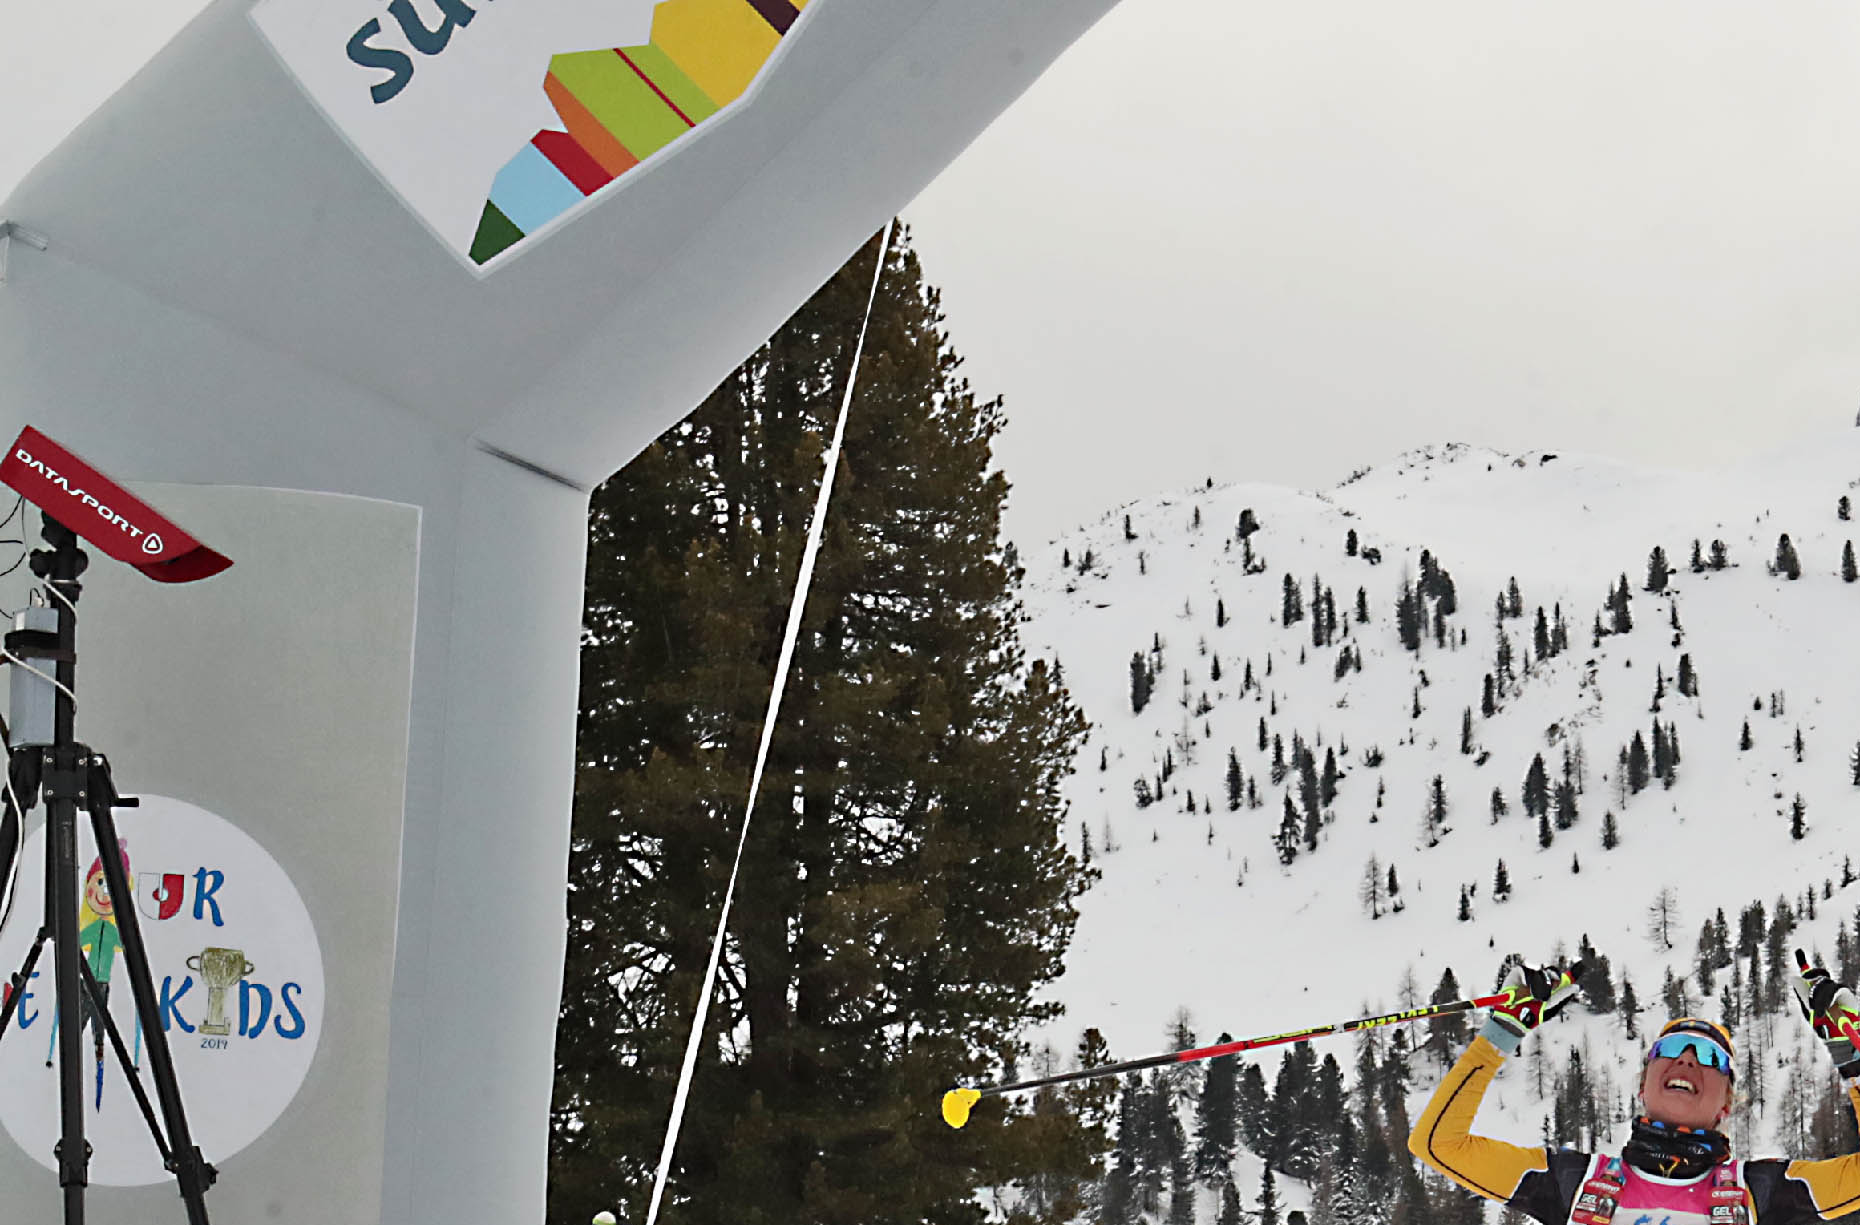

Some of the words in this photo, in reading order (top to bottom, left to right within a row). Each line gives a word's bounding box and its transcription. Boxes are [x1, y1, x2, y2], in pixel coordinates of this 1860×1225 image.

[15, 448, 144, 538] DATASPORT
[200, 1037, 228, 1050] 2019
[1712, 1206, 1732, 1216] GEL
